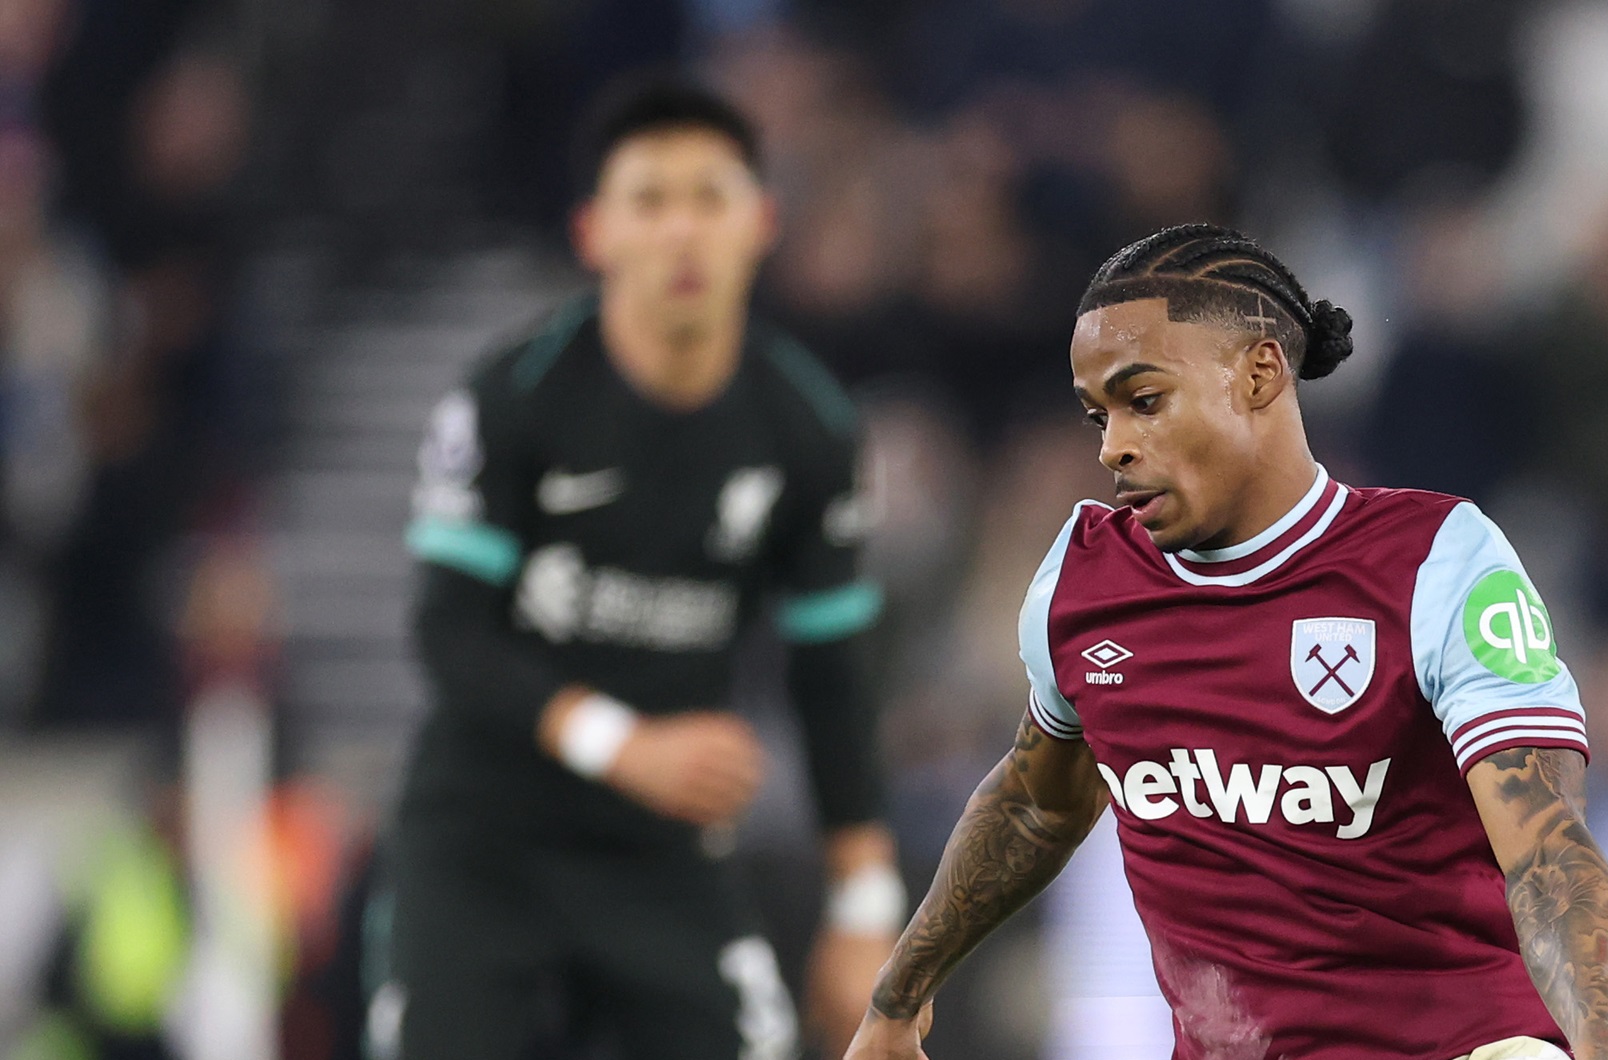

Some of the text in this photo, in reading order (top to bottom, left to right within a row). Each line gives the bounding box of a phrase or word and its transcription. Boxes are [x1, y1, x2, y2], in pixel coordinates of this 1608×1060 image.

[1303, 622, 1367, 635] WEST HAM
[1315, 633, 1354, 641] UNITED
[1085, 669, 1124, 685] umbro
